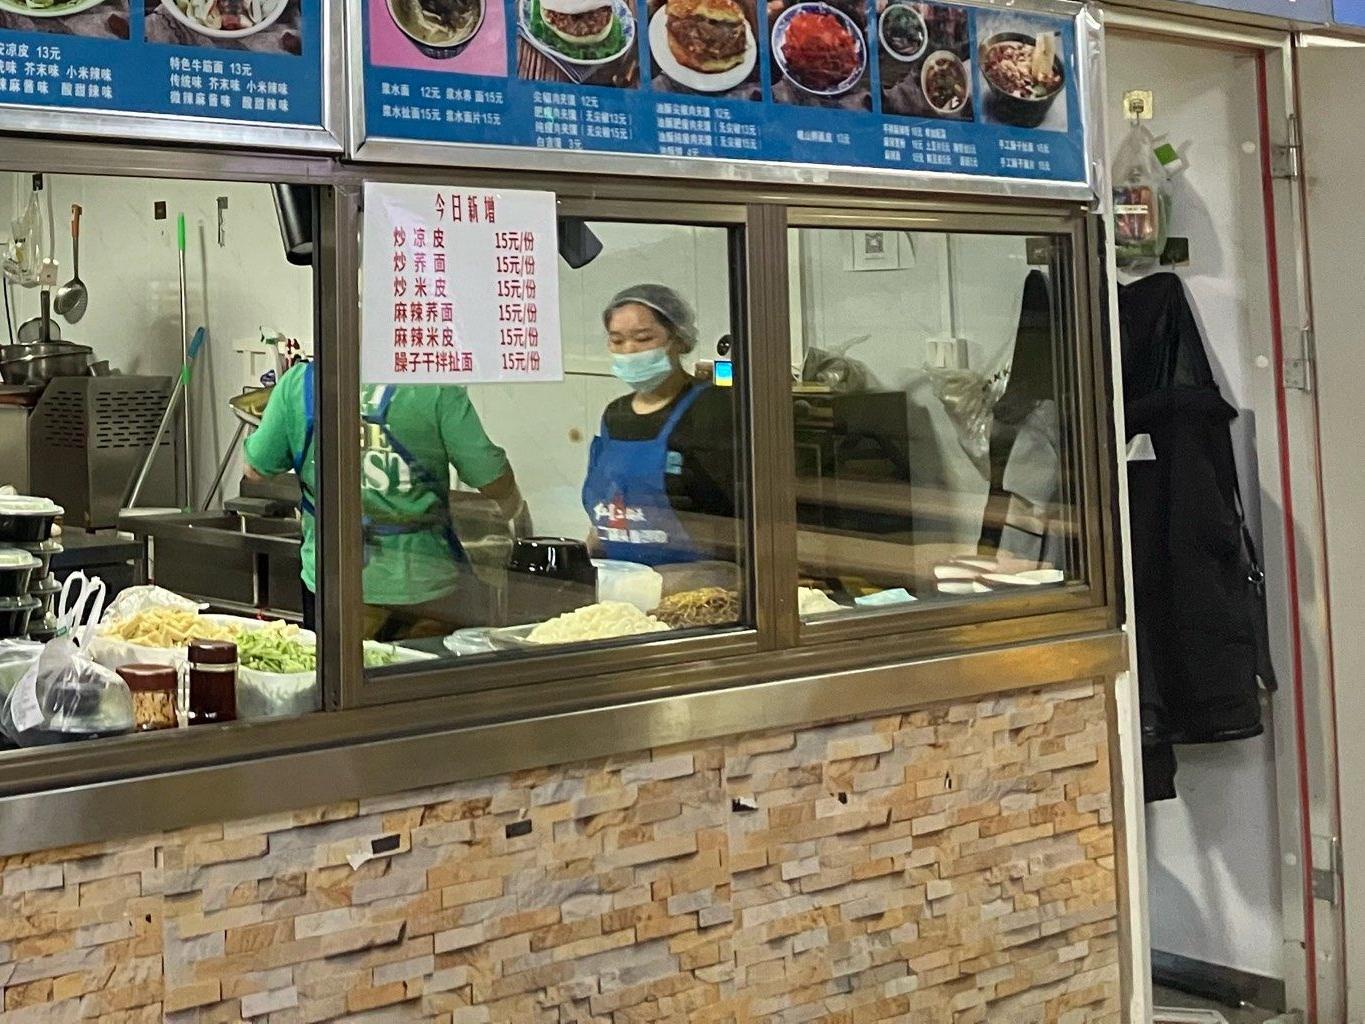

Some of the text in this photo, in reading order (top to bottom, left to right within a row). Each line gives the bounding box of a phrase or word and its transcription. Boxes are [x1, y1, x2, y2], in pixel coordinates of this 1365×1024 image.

[36, 46, 61, 60] 13元
[24, 62, 59, 77] 芥末味
[66, 65, 112, 82] 小米辣味
[435, 193, 495, 223] 今日新增
[393, 227, 534, 252] 炒凉皮 15元/份
[393, 253, 535, 276] 炒荞面 15元/份
[393, 277, 536, 300] 炒米皮 15元/份
[394, 301, 537, 324] 麻辣荞面 15元/份
[394, 327, 538, 348] 麻辣米皮 15元/份
[502, 353, 540, 373] 15元/份
